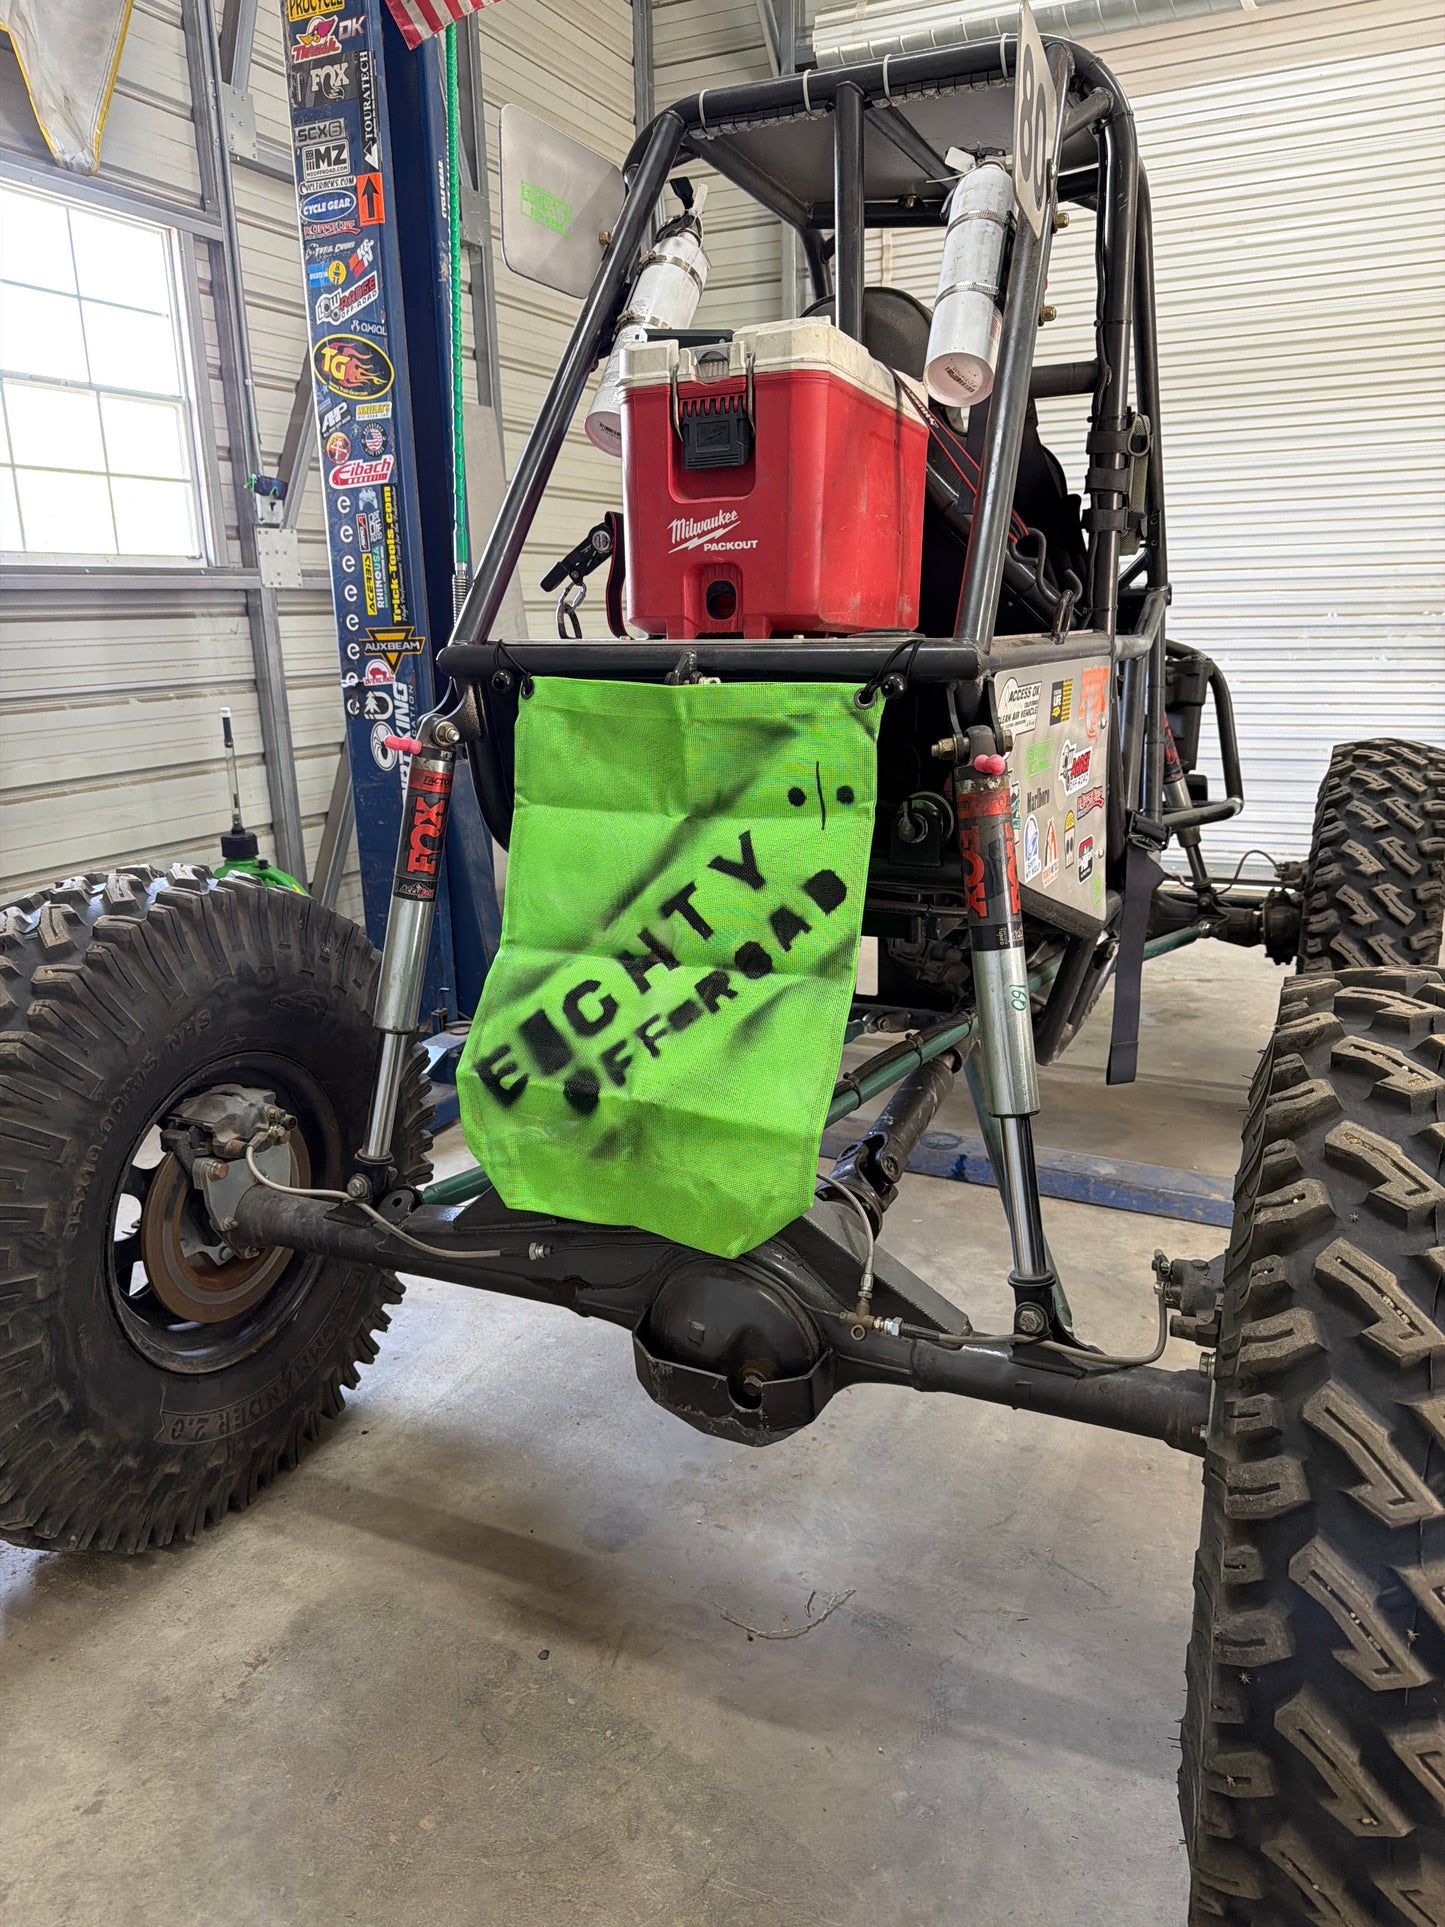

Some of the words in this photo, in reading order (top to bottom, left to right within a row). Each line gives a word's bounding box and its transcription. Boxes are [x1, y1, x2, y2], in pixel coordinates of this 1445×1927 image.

[310, 63, 349, 98] FOX
[360, 51, 373, 139] TOURATECH
[297, 120, 342, 142] SCX6
[1019, 43, 1047, 211] 80
[314, 143, 347, 170] MZ
[303, 202, 327, 215] CYCLE
[327, 198, 352, 211] GEAR
[321, 347, 351, 381] TG
[333, 457, 392, 483] Eibach
[667, 509, 739, 544] Milwaukee
[384, 485, 402, 623] Trick-Tools.com
[703, 540, 758, 552] PACKOUT
[364, 641, 420, 651] AUXBEAM
[1026, 787, 1050, 813] Marlboro
[407, 796, 446, 875] FOX
[960, 825, 987, 917] FOX
[477, 829, 765, 1107] EIGHTY
